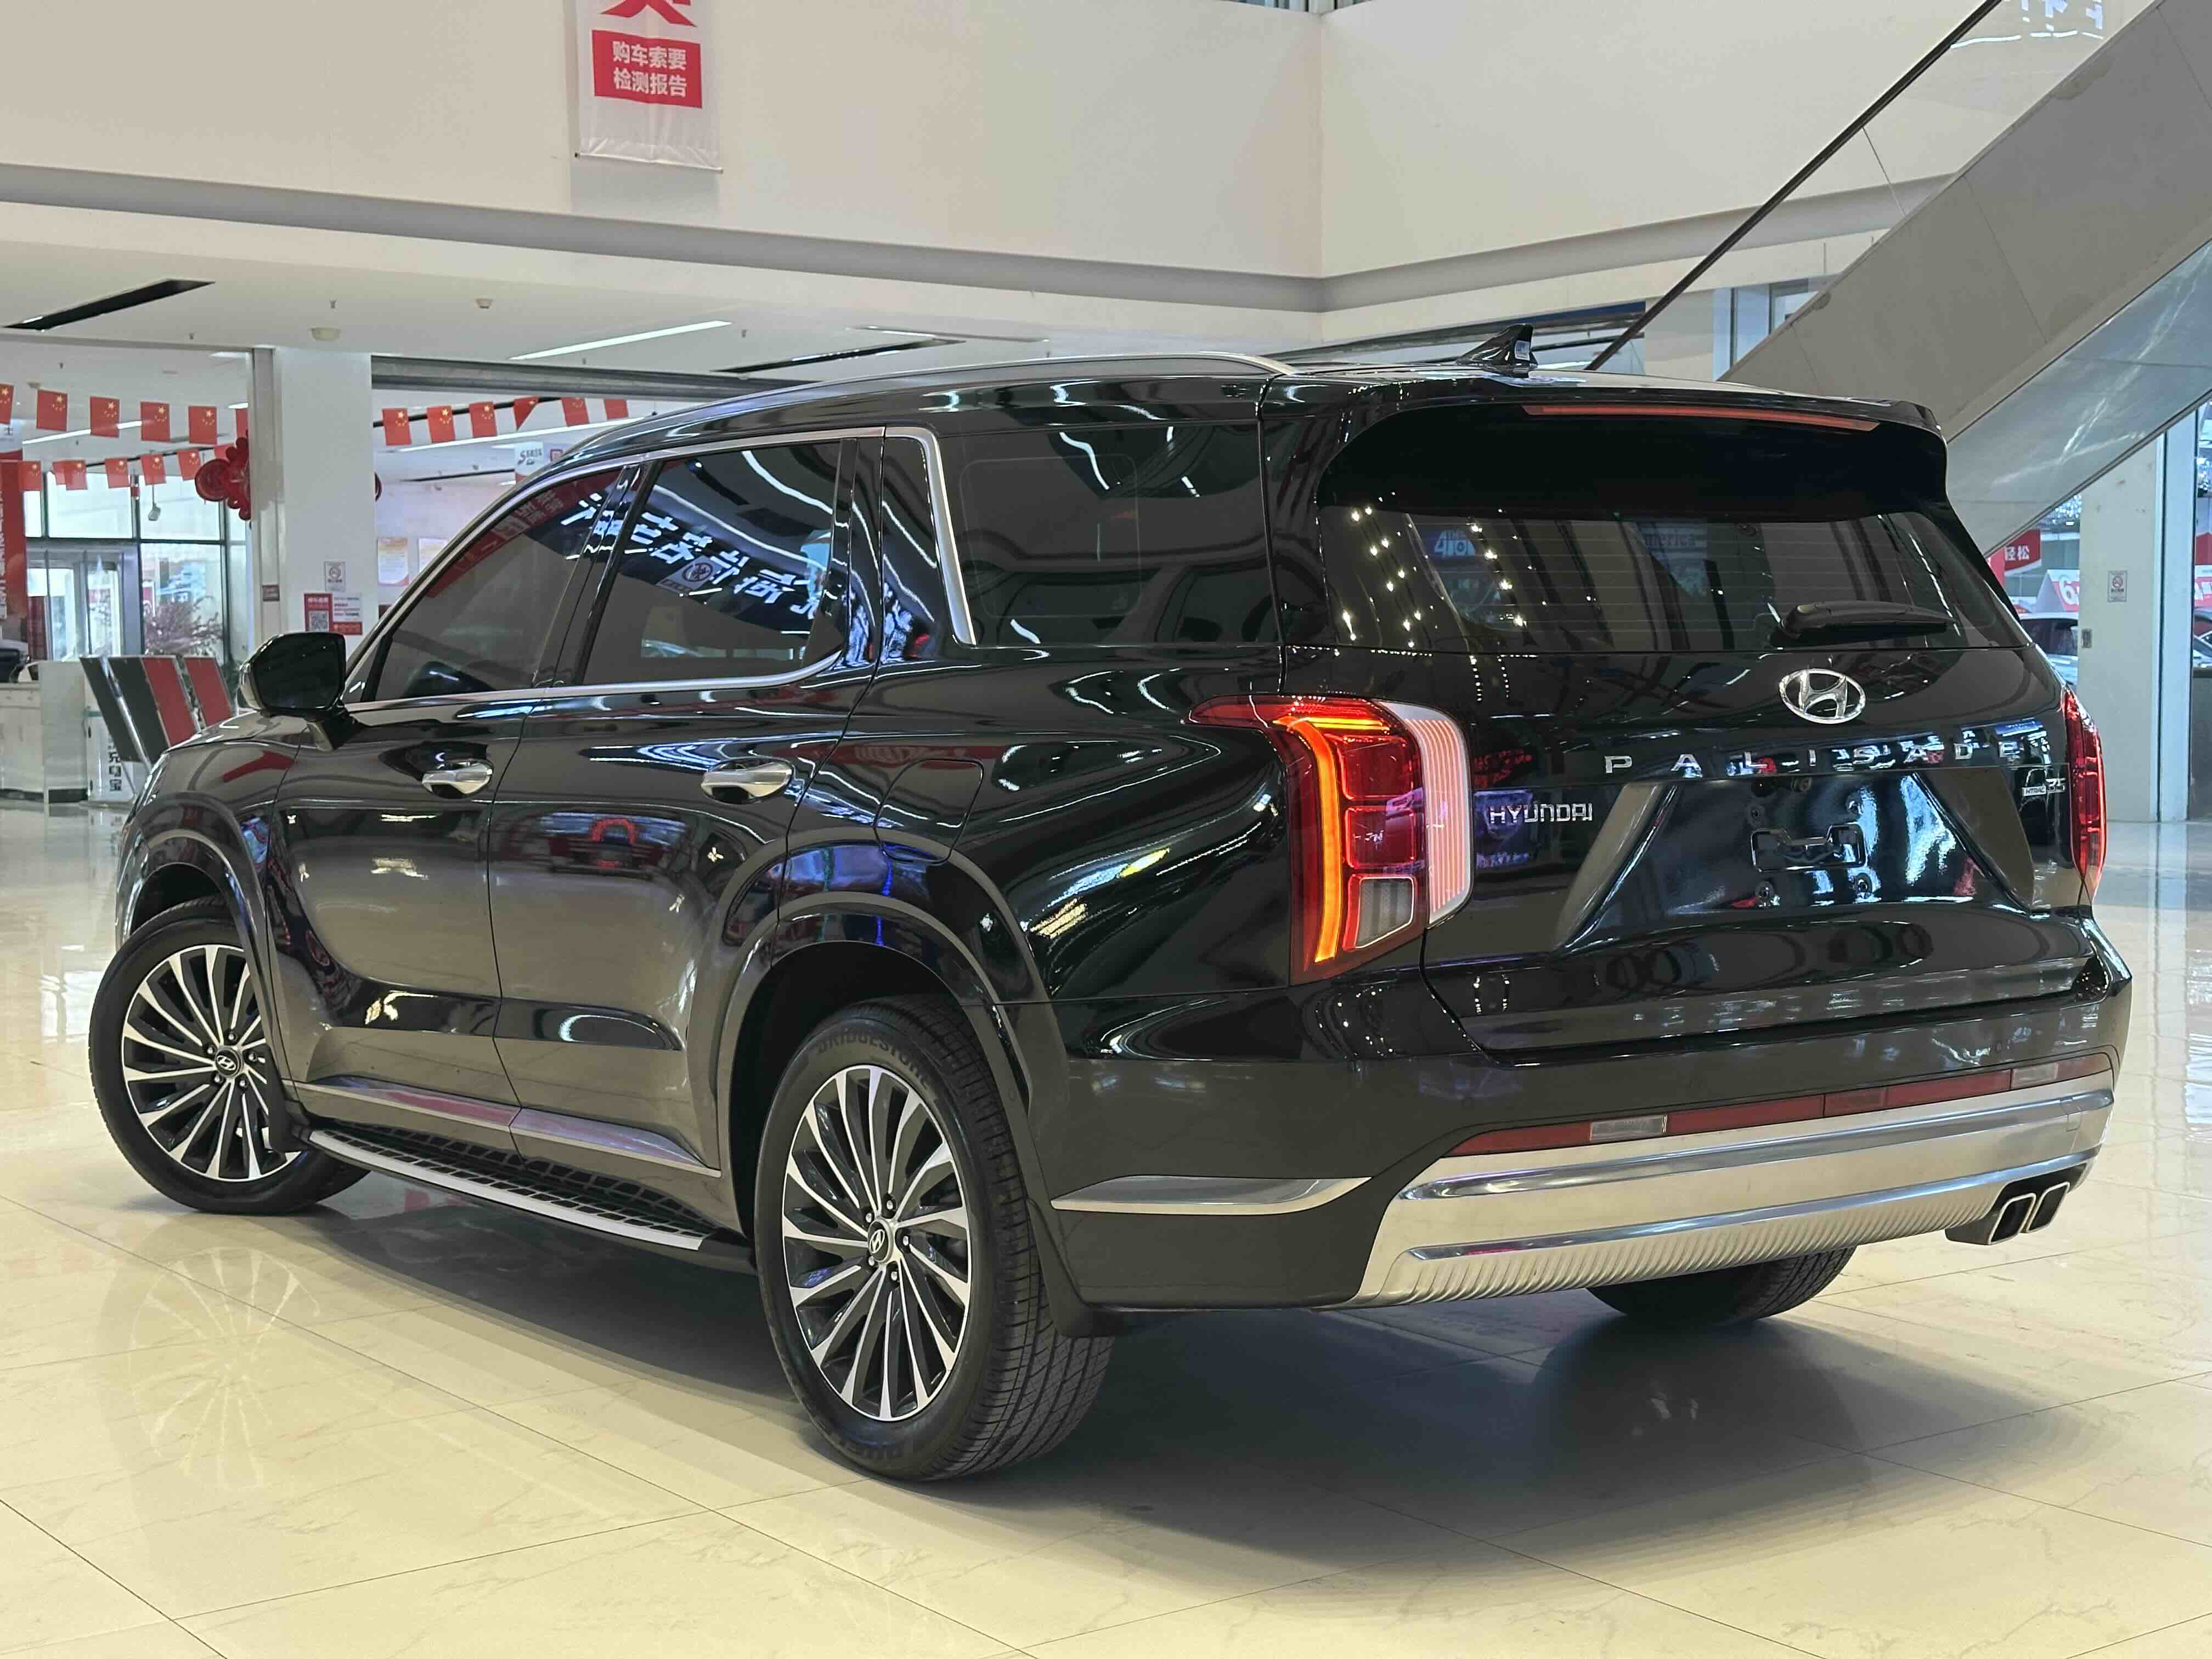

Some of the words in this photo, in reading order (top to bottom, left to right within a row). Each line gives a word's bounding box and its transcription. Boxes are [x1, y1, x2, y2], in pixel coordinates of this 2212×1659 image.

[612, 41, 686, 70] 购车索要
[613, 67, 687, 97] 检测报告
[1604, 741, 2020, 774] PALISADE
[1489, 803, 1593, 824] HYUNDAI
